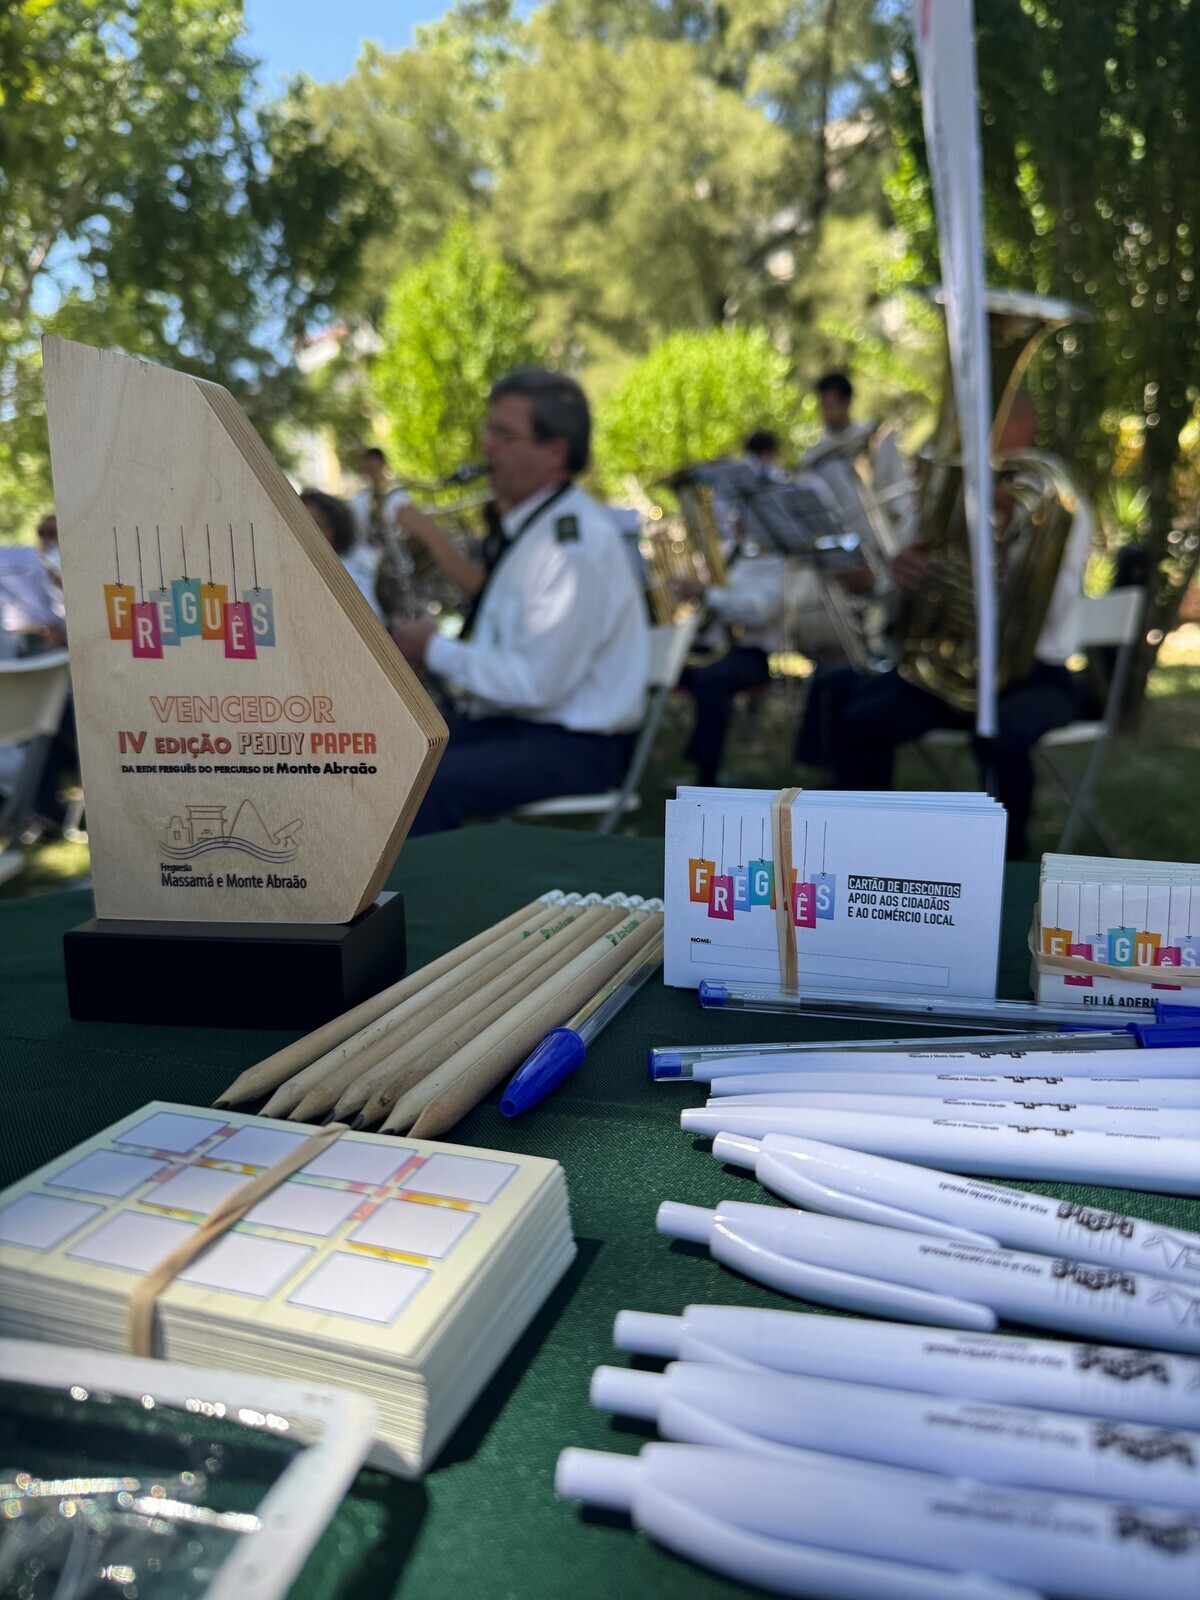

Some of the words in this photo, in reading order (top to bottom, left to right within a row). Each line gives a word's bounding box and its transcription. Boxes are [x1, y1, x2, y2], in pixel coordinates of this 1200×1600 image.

[113, 591, 270, 650] FREGUÊS
[150, 696, 335, 723] VENCEDOR
[118, 731, 147, 754] IV
[155, 733, 232, 758] EDIÇÃO
[237, 732, 305, 755] PEDDY
[310, 732, 377, 755] PAPER
[122, 765, 135, 774] DA
[136, 765, 158, 774] REDE
[158, 763, 198, 774] FREGUÊS
[198, 765, 212, 774] DO
[214, 765, 261, 774] PERCURSO
[262, 765, 275, 774] DE
[276, 762, 321, 774] Monte
[323, 762, 377, 775] Abraão
[160, 863, 193, 873] Freguesia
[161, 873, 214, 887] Massamá
[216, 878, 224, 887] e
[226, 874, 264, 888] Monte
[266, 874, 307, 889] Abraão
[848, 877, 885, 891] CARTÃO
[887, 880, 900, 893] DE
[902, 881, 960, 897] DESCONTOS
[695, 868, 831, 921] FREGÊS
[848, 892, 877, 905] APOIO
[879, 895, 899, 907] AOS
[901, 896, 950, 911] CIDADÃOS
[848, 906, 854, 917] E
[856, 907, 869, 919] AO
[871, 908, 921, 923] COMÉRCIO
[924, 912, 955, 926] LOCAL
